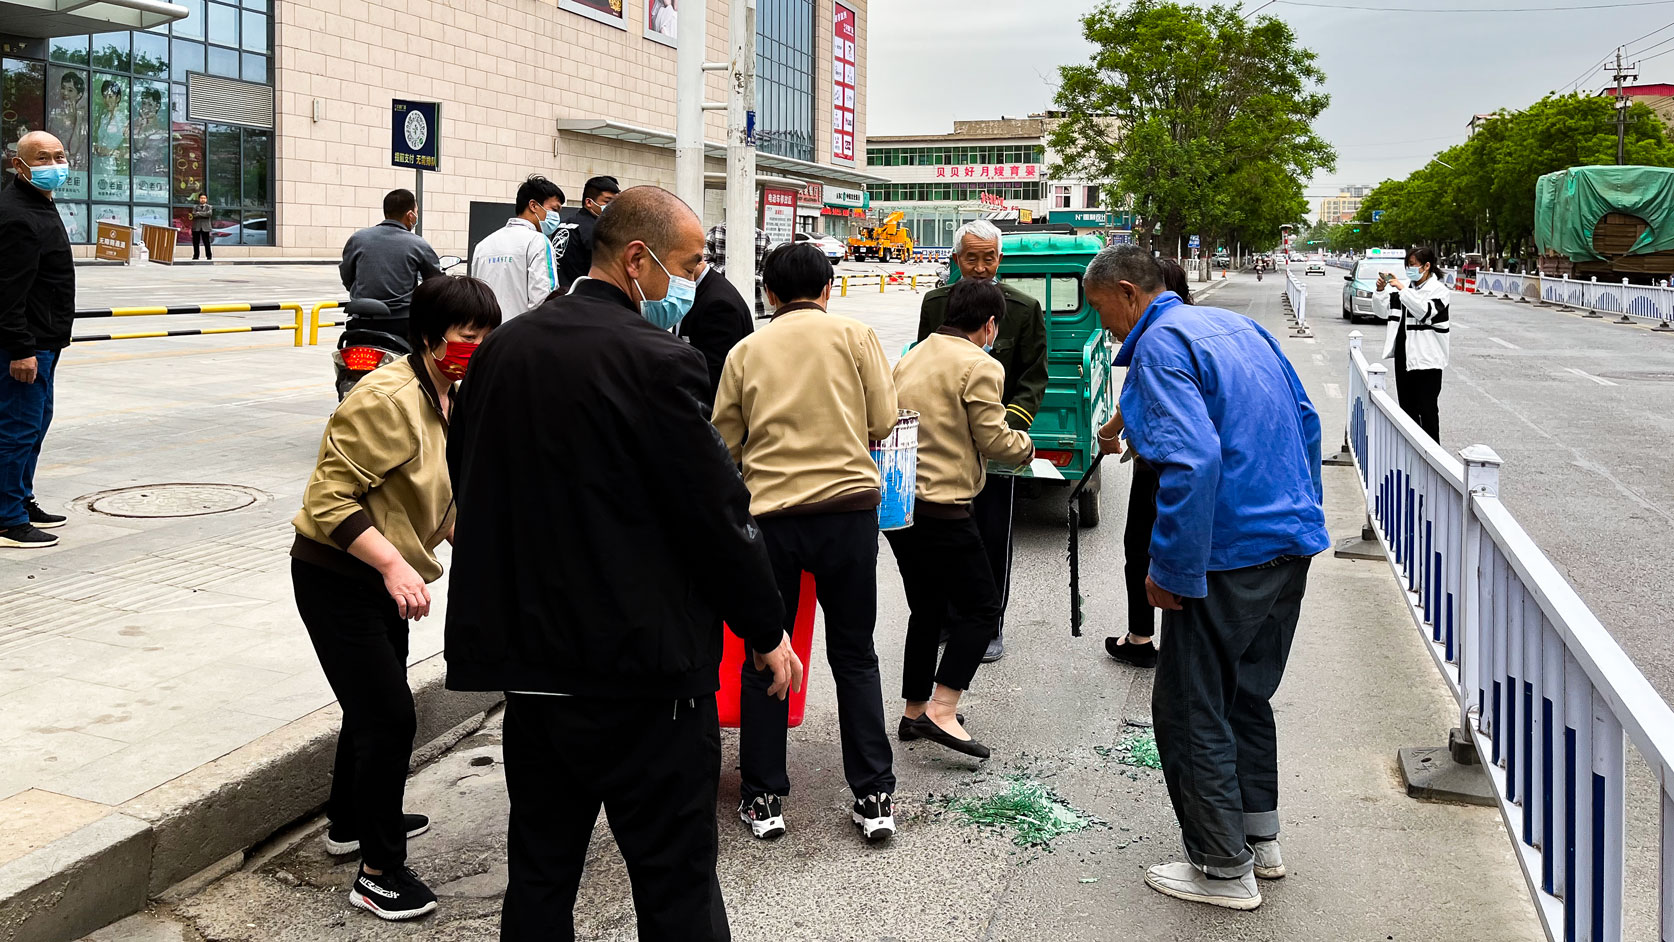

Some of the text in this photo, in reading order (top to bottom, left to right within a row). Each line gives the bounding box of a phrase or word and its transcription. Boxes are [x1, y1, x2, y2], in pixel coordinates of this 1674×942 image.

[936, 165, 1036, 178] 贝贝好月嫂育婴
